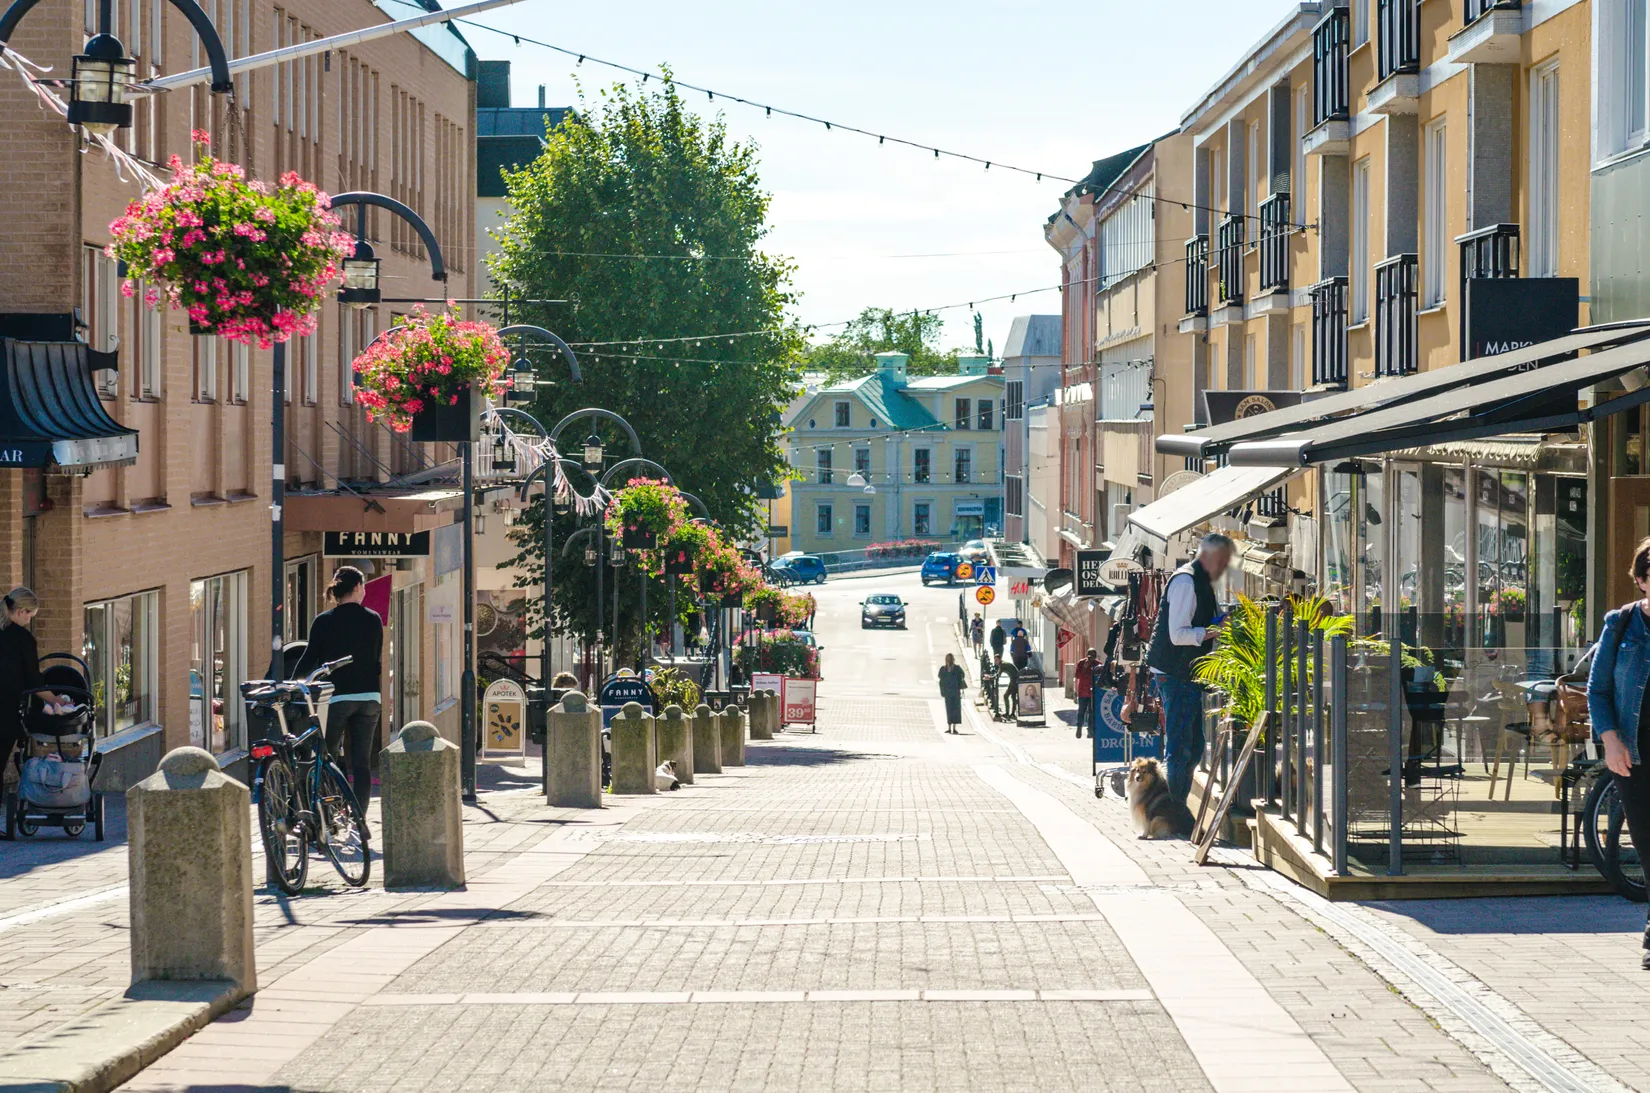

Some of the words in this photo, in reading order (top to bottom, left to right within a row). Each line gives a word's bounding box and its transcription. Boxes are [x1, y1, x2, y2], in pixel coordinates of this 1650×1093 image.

[1238, 399, 1251, 413] SAM
[339, 532, 413, 546] FANNY
[1081, 570, 1099, 580] OS
